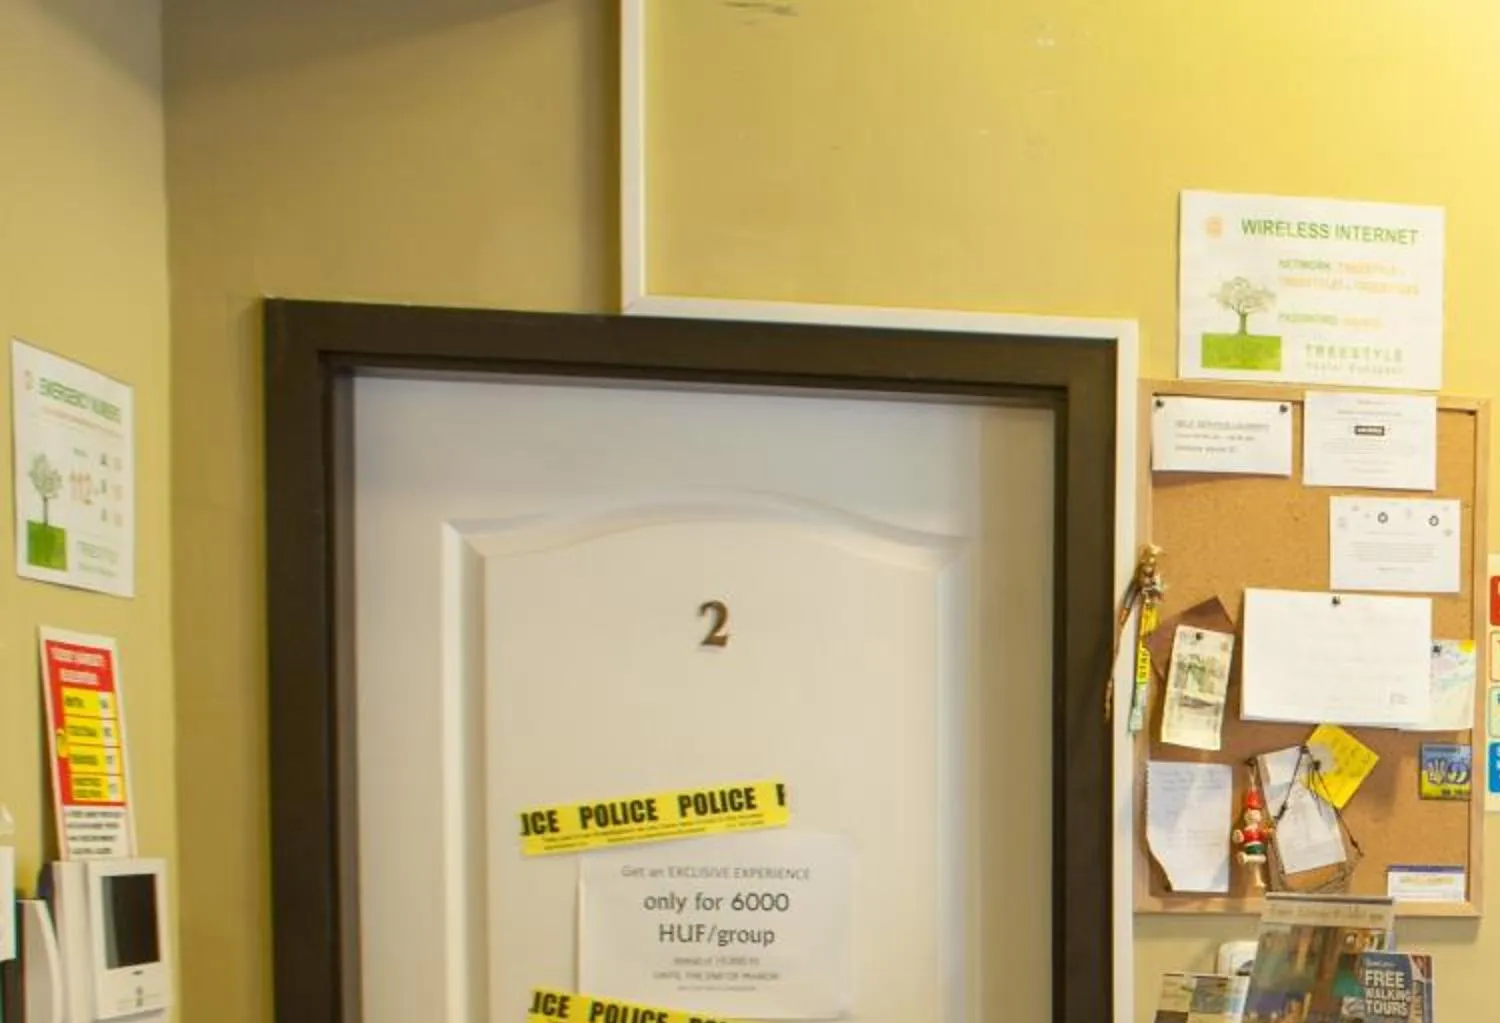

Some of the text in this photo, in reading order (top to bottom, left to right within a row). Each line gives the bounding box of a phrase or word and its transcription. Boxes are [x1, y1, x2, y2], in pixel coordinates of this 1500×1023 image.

[1242, 218, 1419, 246] WIRELESS INTERNET
[1306, 344, 1403, 362] TREESTYLE
[697, 600, 728, 648] 2
[520, 810, 560, 836] ICE
[579, 798, 658, 829] POLICE
[677, 787, 757, 817] POLICE
[621, 864, 810, 881] Get an EXCLUSIVE EXPERIENCE
[644, 892, 790, 914] only for 6000
[659, 923, 775, 946] HUF/group
[1365, 970, 1405, 989] FREE
[529, 991, 570, 1018] ICE
[1365, 1000, 1408, 1017] TOURS
